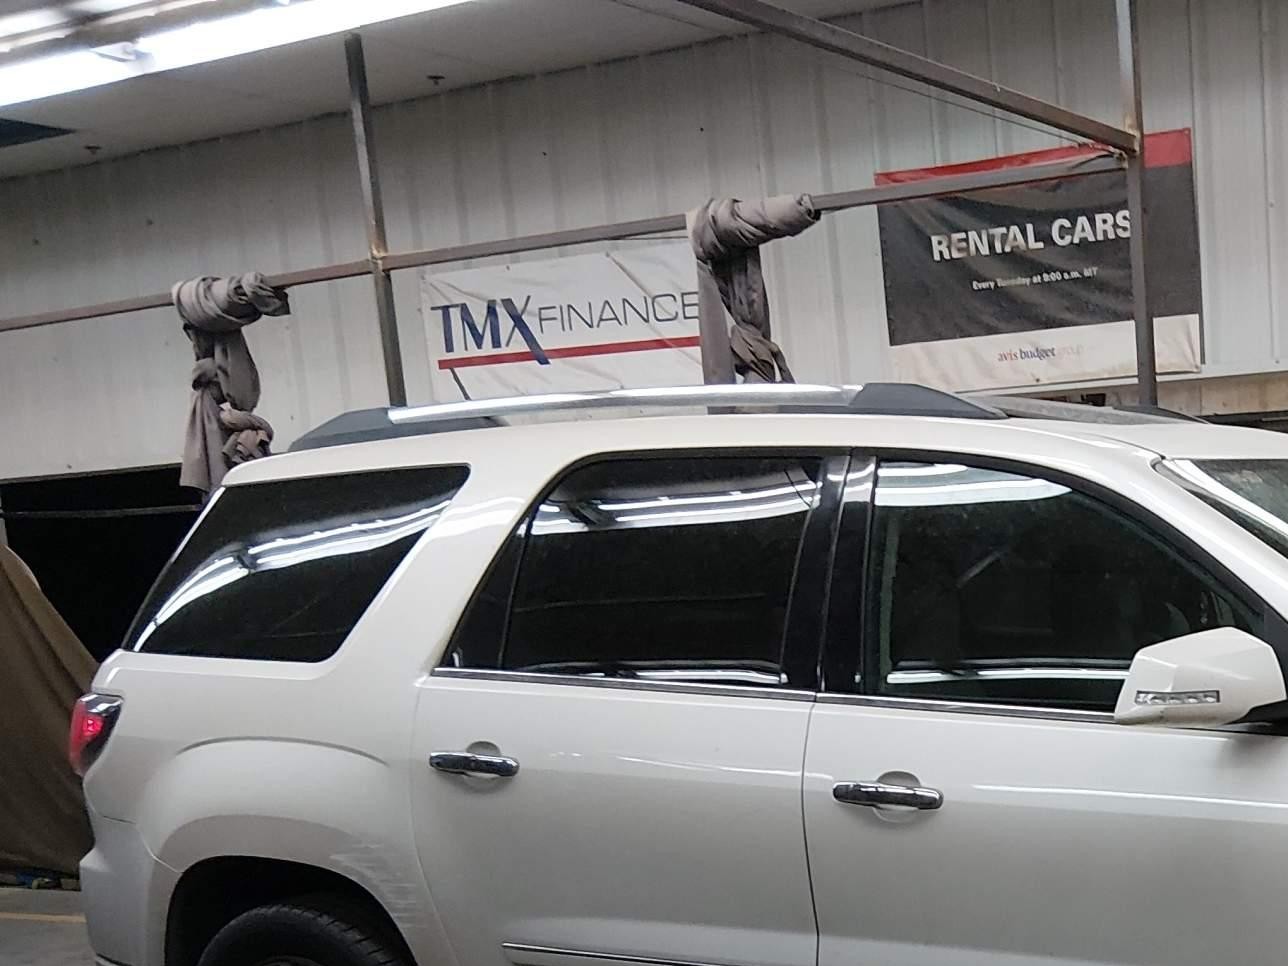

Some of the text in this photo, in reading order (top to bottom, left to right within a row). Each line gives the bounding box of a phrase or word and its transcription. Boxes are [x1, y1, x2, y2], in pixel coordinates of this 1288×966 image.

[930, 209, 1131, 262] RENTAL CARS
[430, 290, 700, 366] TMX FINANCE
